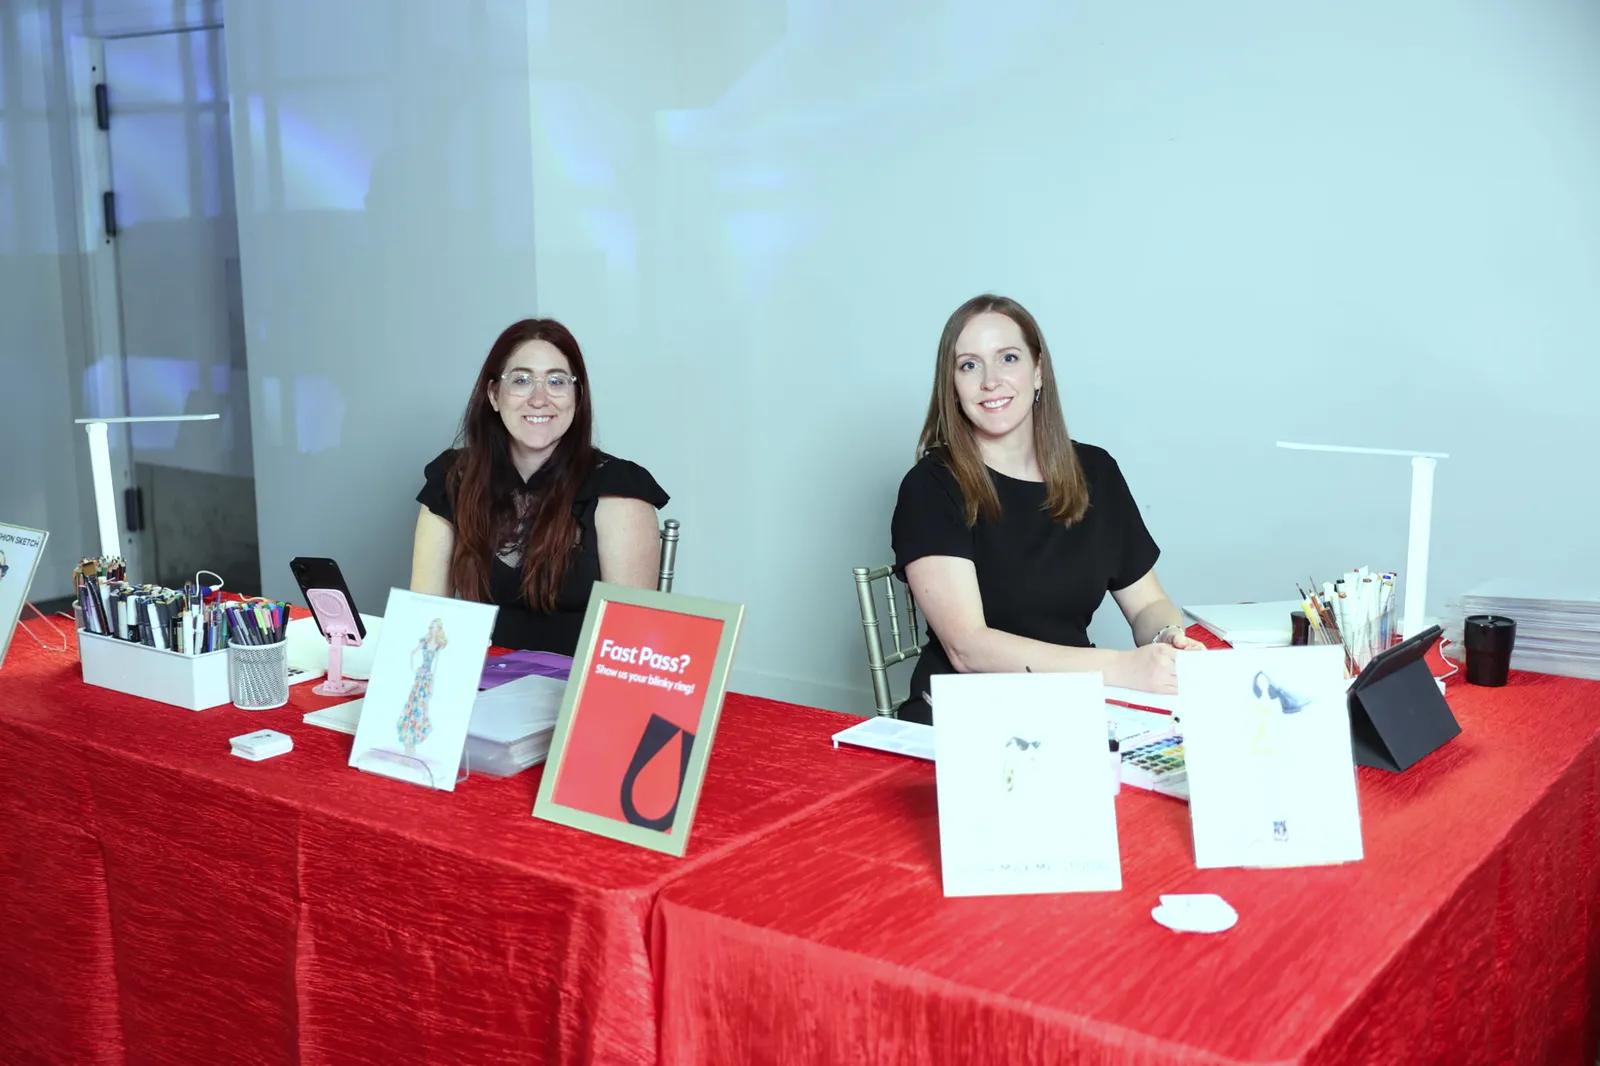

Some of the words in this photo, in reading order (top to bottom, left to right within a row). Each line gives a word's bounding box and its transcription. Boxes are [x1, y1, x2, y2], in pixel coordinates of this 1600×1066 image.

[15, 536, 39, 548] SKETCH
[600, 639, 639, 664] Fast
[638, 646, 691, 674] Pass?
[595, 664, 618, 677] Show
[618, 670, 628, 680] us
[628, 673, 648, 683] your
[647, 674, 675, 691] blinky
[673, 680, 696, 696] ring!
